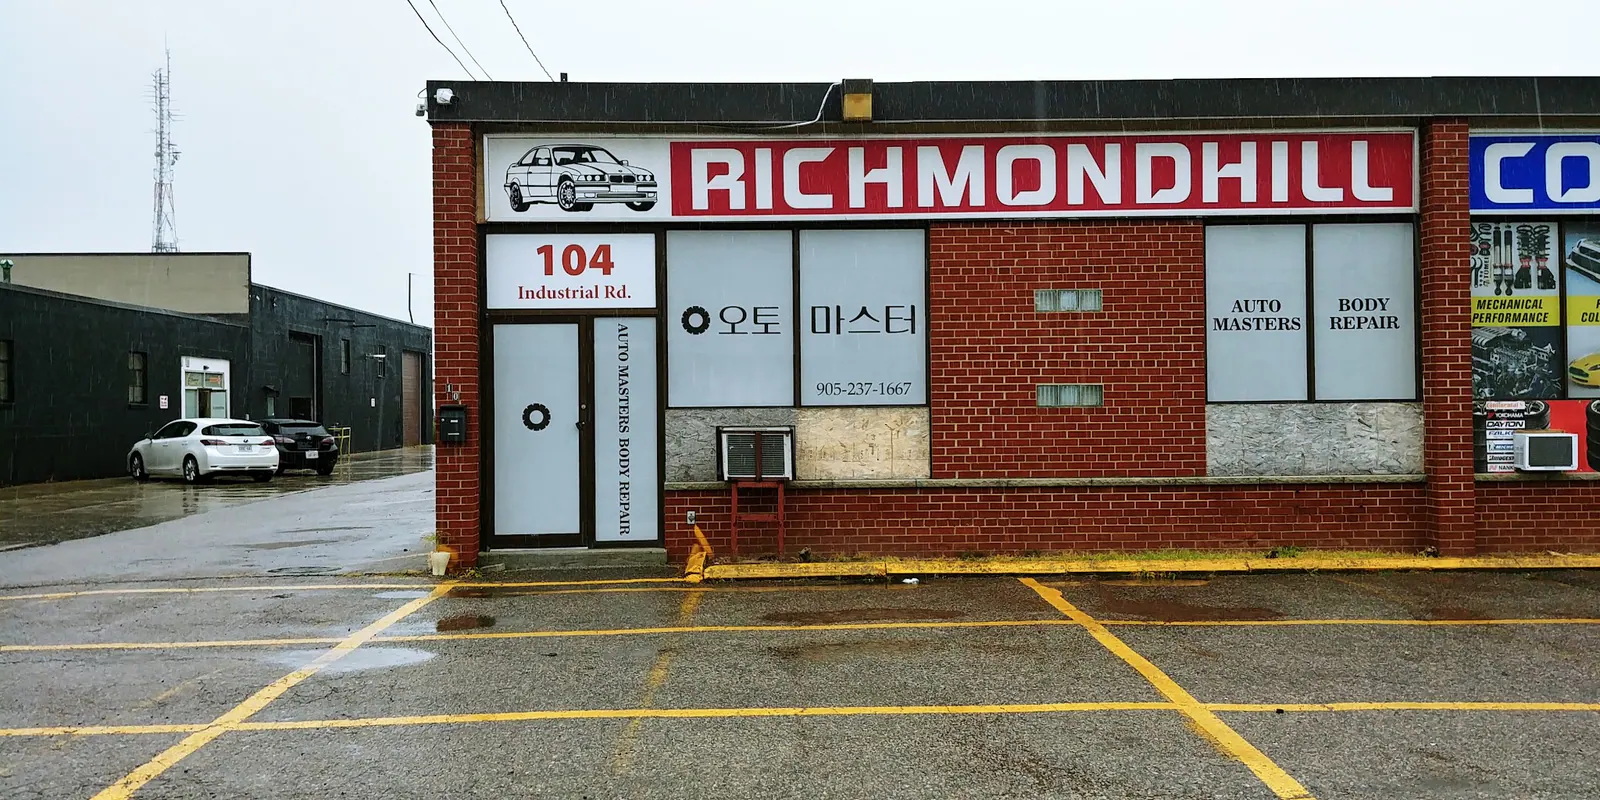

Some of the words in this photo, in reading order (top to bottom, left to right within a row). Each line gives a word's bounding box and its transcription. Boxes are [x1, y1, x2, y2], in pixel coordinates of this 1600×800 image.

[691, 140, 1394, 211] RICHMONDHILL
[536, 244, 615, 276] 104
[517, 284, 600, 301] Industrial
[604, 284, 632, 300] Rd.
[1231, 298, 1282, 313] AUTO
[1338, 297, 1390, 312] BODY
[1476, 299, 1544, 310] MECHANICAL
[718, 305, 781, 336] 오토
[811, 304, 917, 336] 마스터
[1212, 316, 1301, 332] MASTERS
[1329, 315, 1400, 330] REPAIR
[1472, 312, 1549, 324] PERFORMANCE
[617, 323, 629, 362] AUTO
[816, 382, 912, 396] 905-237-1667
[618, 365, 630, 434] MASTERS
[619, 438, 630, 479] BODY
[619, 481, 631, 536] REPAIR
